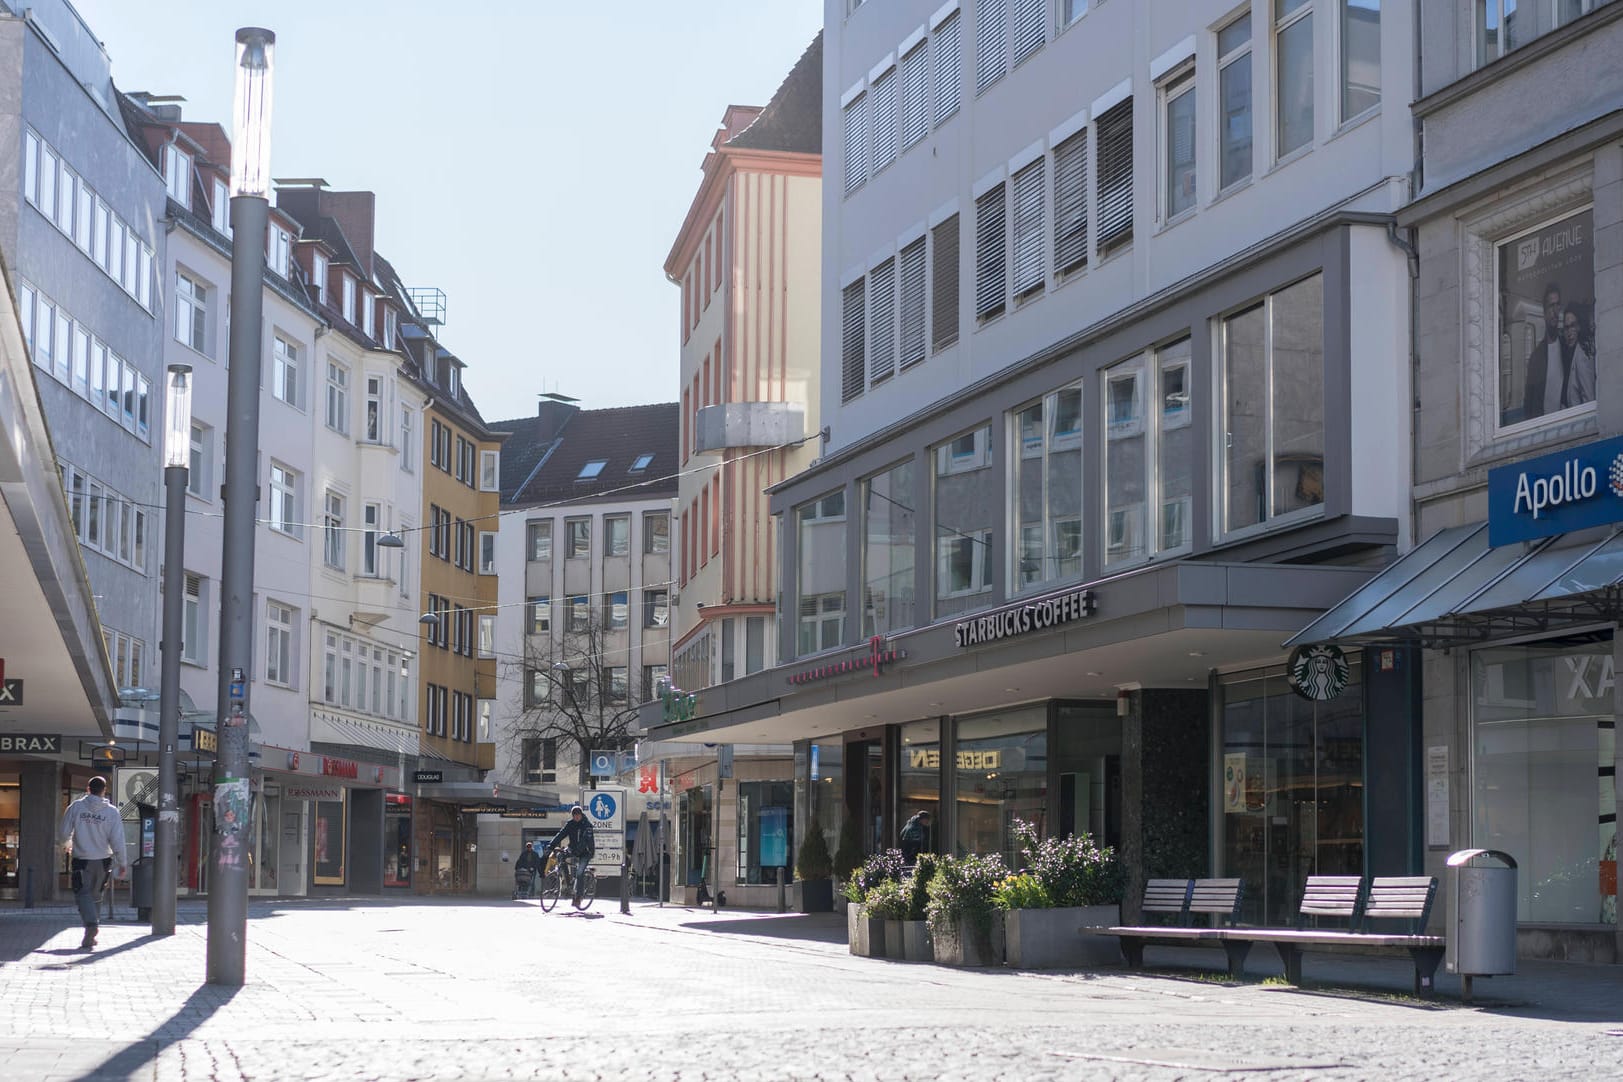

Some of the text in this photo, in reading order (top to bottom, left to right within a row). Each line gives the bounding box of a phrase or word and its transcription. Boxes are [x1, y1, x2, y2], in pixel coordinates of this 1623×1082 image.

[1542, 224, 1583, 256] AVENUE
[1513, 458, 1597, 520] Apollo
[954, 589, 1089, 647] STARBUCKS COFFEE
[1, 736, 56, 751] BRAX
[287, 788, 338, 799] ROSSMANN
[144, 819, 153, 831] P
